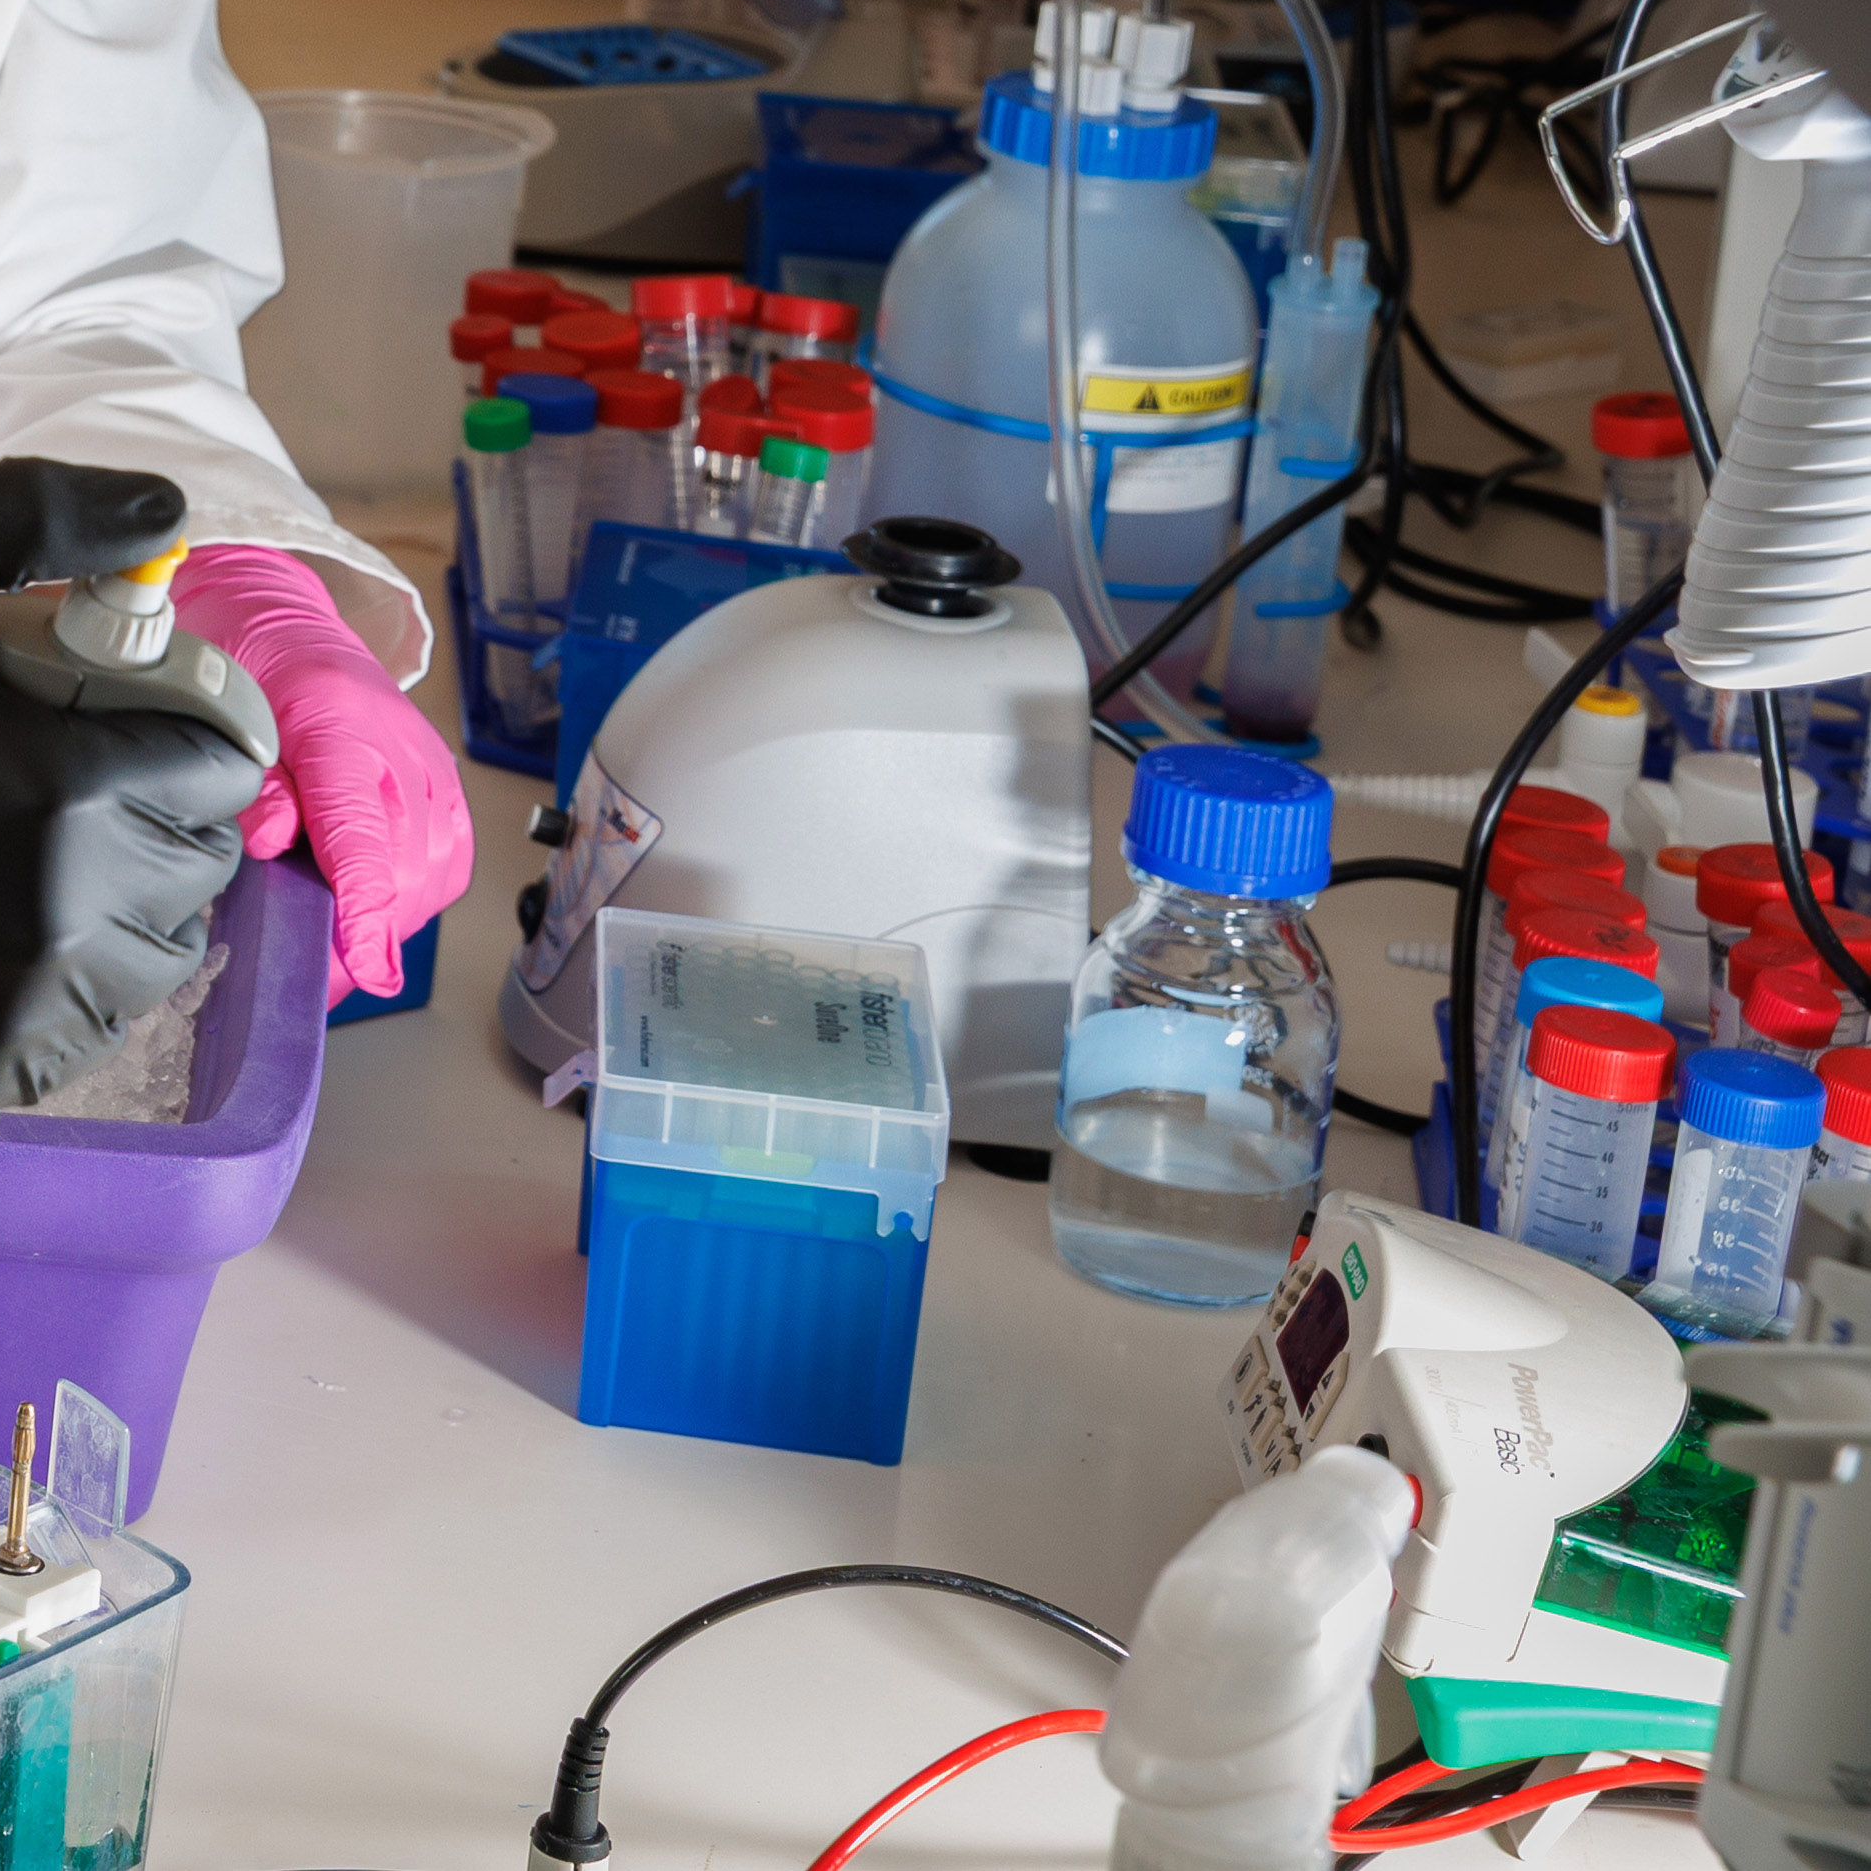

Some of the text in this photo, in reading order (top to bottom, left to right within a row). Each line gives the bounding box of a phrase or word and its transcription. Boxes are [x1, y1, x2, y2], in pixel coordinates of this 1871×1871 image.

[1606, 1120, 1619, 1133] 45
[1601, 1152, 1615, 1164] 40
[1595, 1186, 1609, 1199] 35
[1589, 1220, 1603, 1233] 30
[1344, 1248, 1364, 1294] BIO-RAD
[1494, 1428, 1526, 1474] Basic
